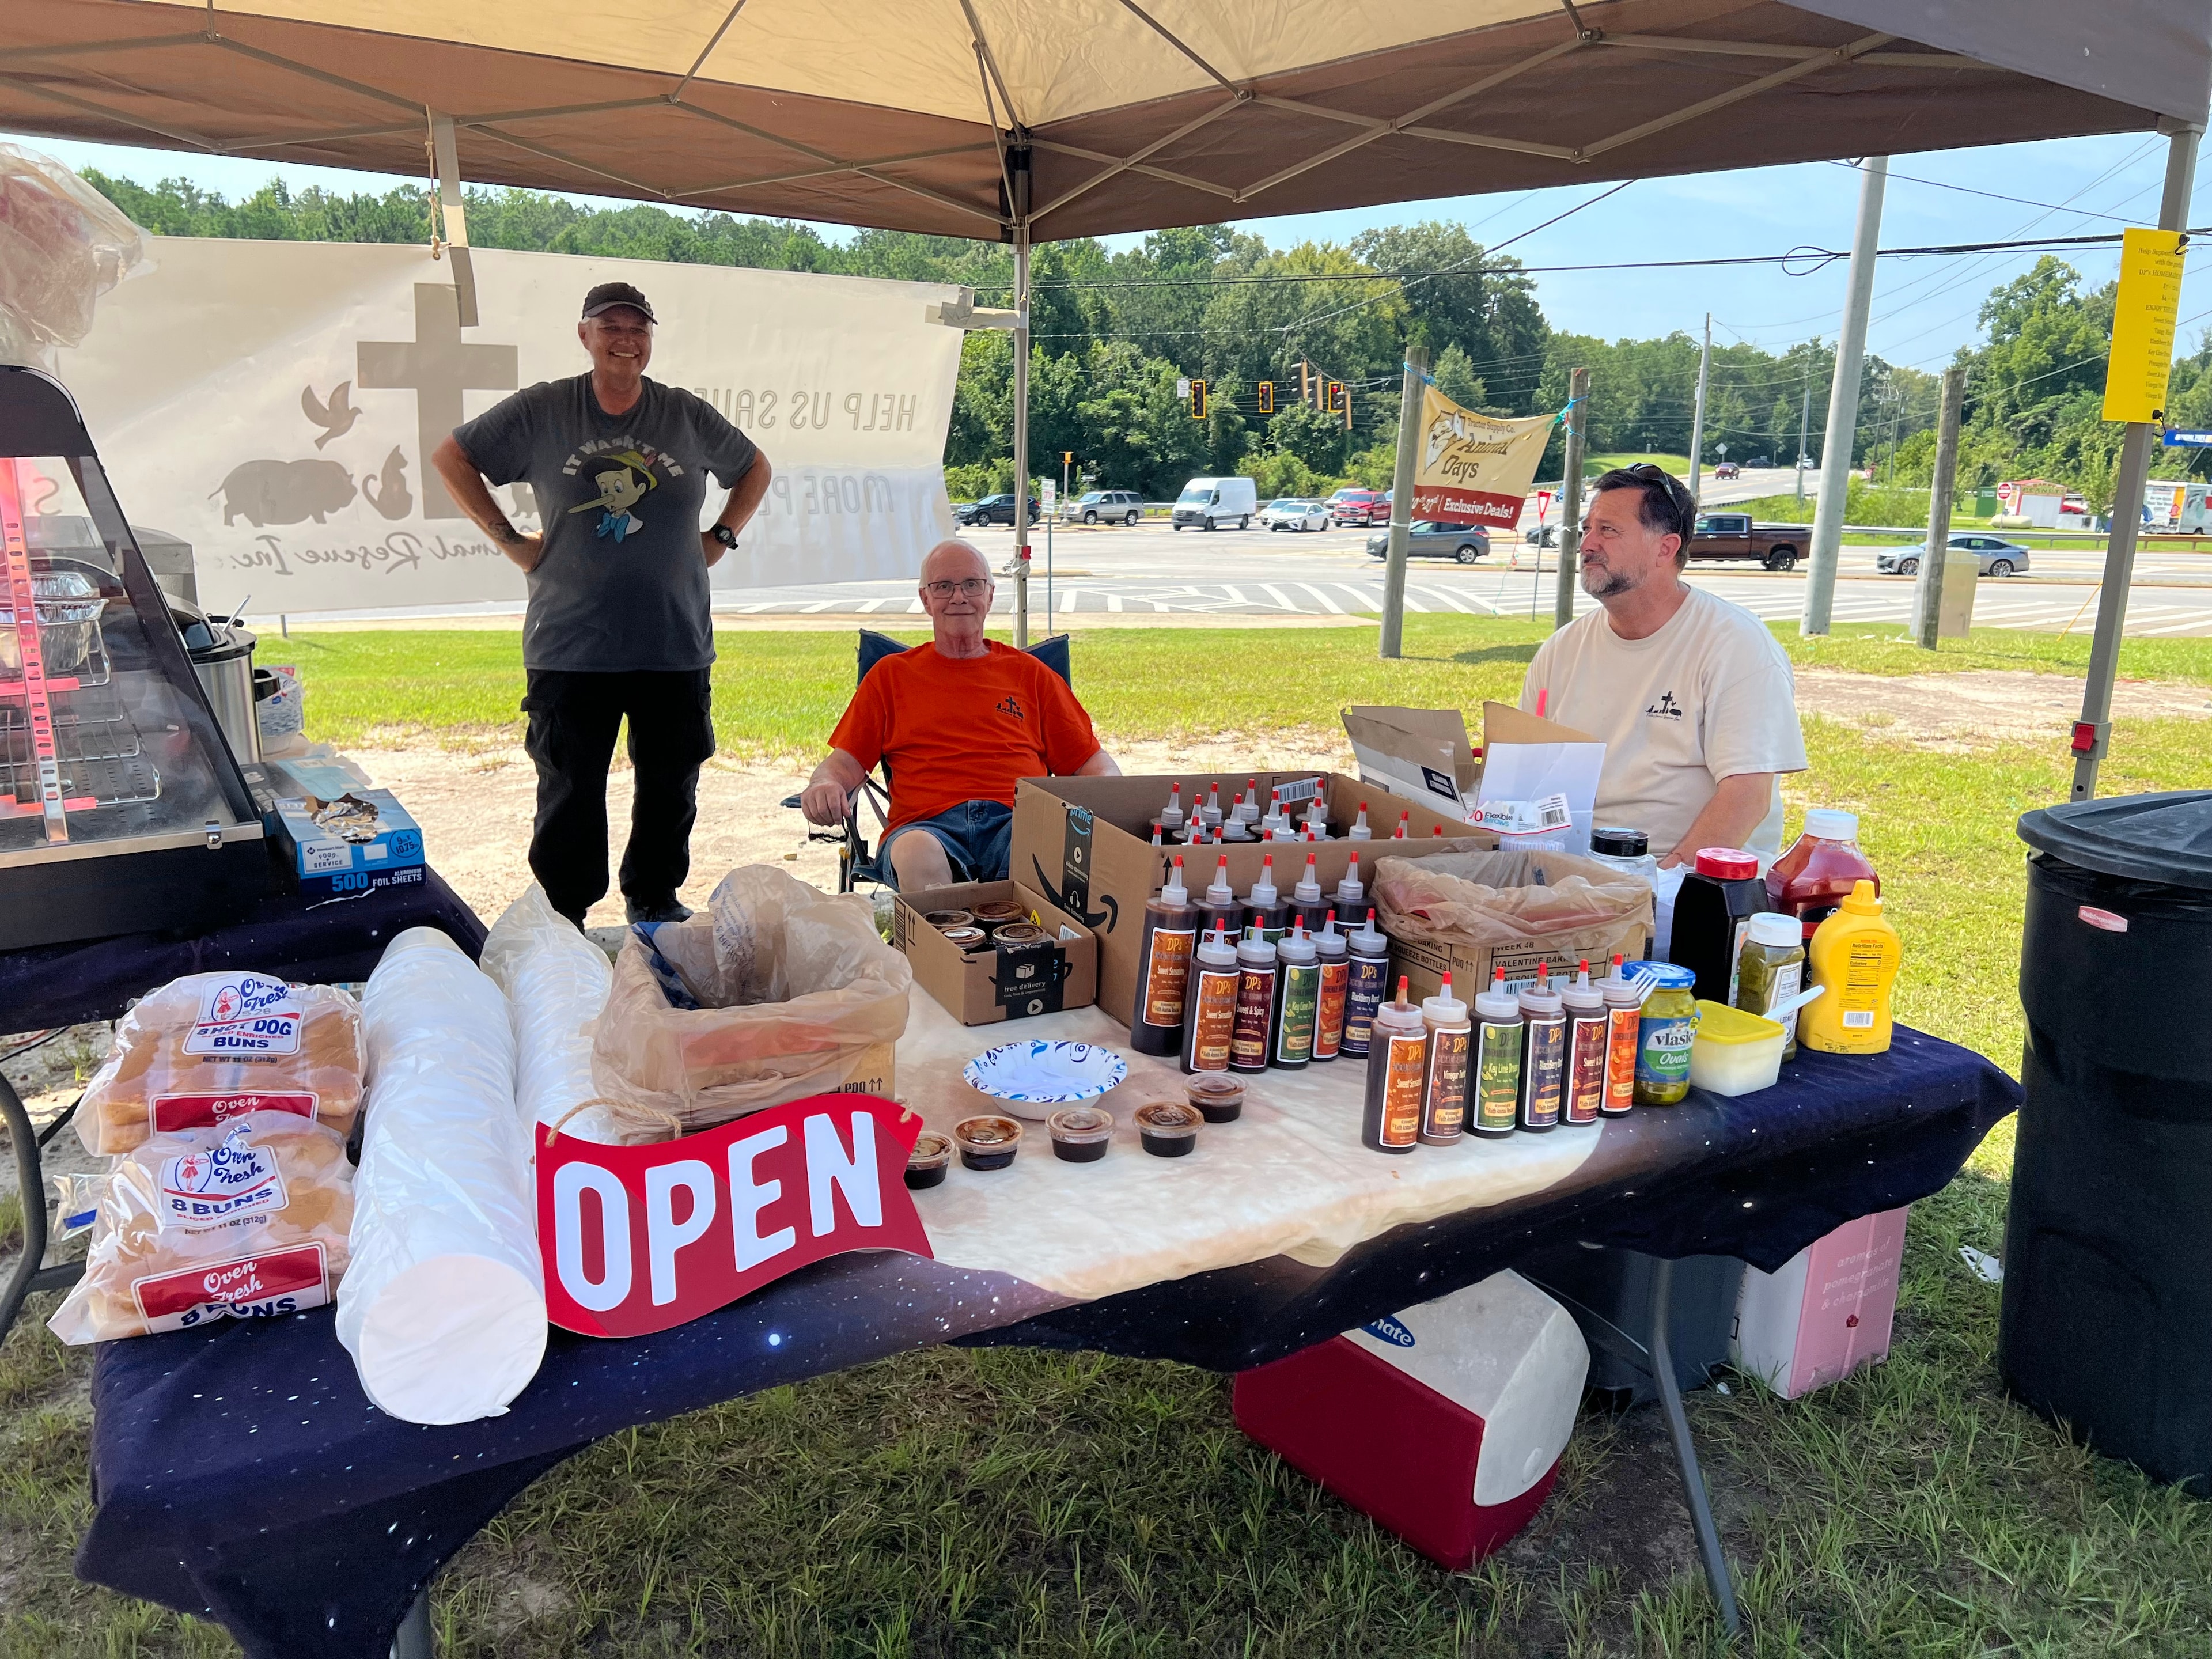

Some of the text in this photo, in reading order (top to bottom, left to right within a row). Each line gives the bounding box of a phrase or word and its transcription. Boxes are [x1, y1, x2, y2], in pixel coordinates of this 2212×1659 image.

[2138, 247, 2151, 255] Help
[1467, 417, 1516, 434] Tractor Supply Co.
[1457, 433, 1516, 456] Animal
[562, 453, 582, 475] IT
[657, 452, 684, 477] ME
[1441, 454, 1479, 484] Days
[1443, 498, 1514, 519] Exclusive Deals!
[1069, 807, 1093, 825] prime
[1483, 817, 1510, 827] Straws
[1484, 812, 1513, 821] Flexible
[396, 836, 403, 845] 9
[314, 860, 343, 868] SERVICE
[394, 868, 422, 876] ALUMINUM
[332, 872, 368, 892] 500
[373, 873, 422, 887] FOIL SHEETS
[1166, 938, 1182, 951] DP's
[1496, 942, 1522, 951] WEEK
[1394, 944, 1464, 971] SQUEEZE BOTTLES PDQ
[1495, 956, 1543, 968] VALENTINE
[1157, 965, 1169, 975] Sweet
[1361, 965, 1377, 979] DP's
[1018, 981, 1046, 990] delivery
[1216, 980, 1231, 995] DP's
[1245, 976, 1262, 990] DP's
[1371, 993, 1380, 1003] Burst
[1206, 1009, 1217, 1019] Sweet
[1237, 1005, 1249, 1015] Sweet
[1254, 1006, 1264, 1018] Spicy
[210, 1022, 250, 1035] HOT
[253, 1019, 292, 1036] DOG
[213, 1036, 269, 1048] BUNS
[237, 1031, 284, 1039] ENRICHED
[1500, 1032, 1516, 1047] DP's
[1548, 1027, 1562, 1043] DP's
[1654, 1031, 1693, 1046] vlasic
[1407, 1044, 1422, 1061] DP's
[1453, 1037, 1467, 1054] DP's
[1584, 1057, 1596, 1067] Sweet
[1660, 1051, 1688, 1065] Ovals
[1444, 1070, 1459, 1082] Vinegar
[1488, 1063, 1498, 1076] Key
[1498, 1063, 1508, 1074] Lime
[844, 1081, 866, 1093] PDQ
[1396, 1078, 1410, 1088] Sweet
[211, 1096, 260, 1113] Oven
[212, 1147, 256, 1165] Oven
[213, 1162, 266, 1184] Fresh
[172, 1188, 272, 1215] 8 BUNS
[554, 1111, 883, 1312] OPEN
[243, 1214, 267, 1226] (312g)
[1838, 1236, 1891, 1267] aromas of
[203, 1260, 258, 1294] Oven
[1823, 1257, 1893, 1294] pomegranate
[211, 1278, 264, 1302] Fresh
[1821, 1275, 1889, 1310] & chamomile
[181, 1312, 201, 1327] 8
